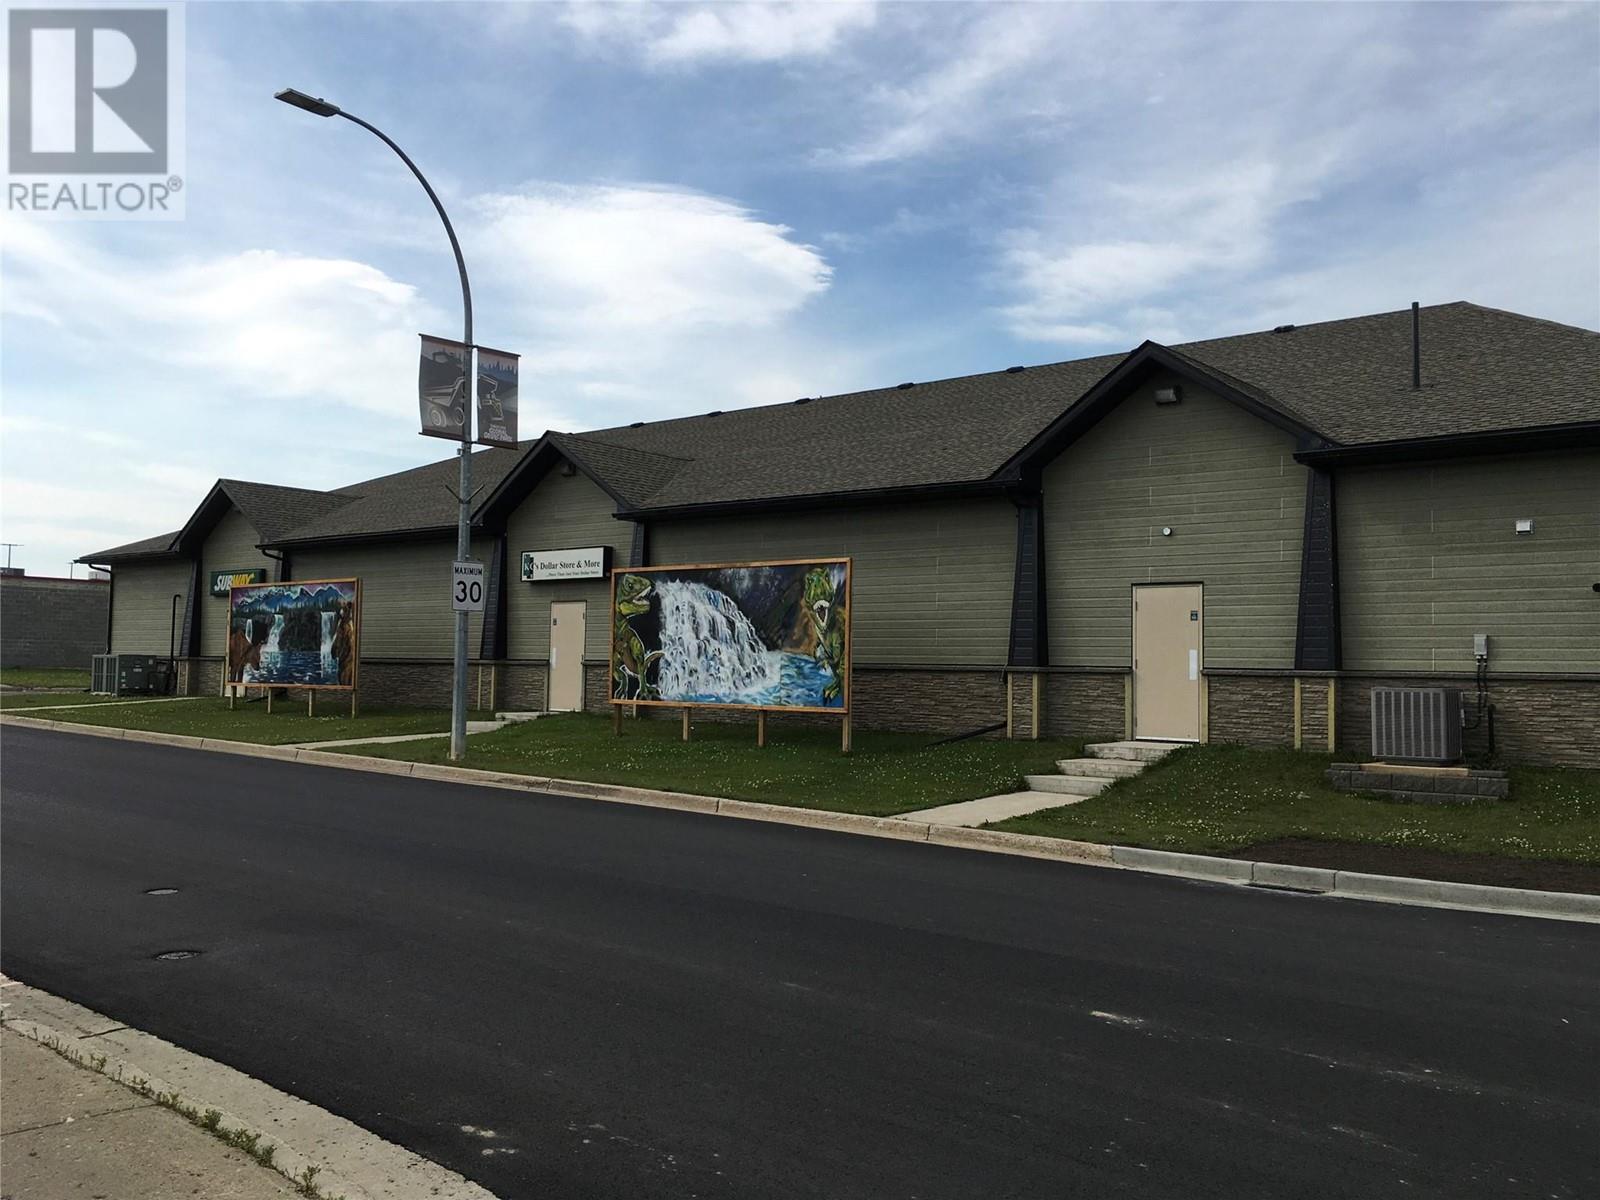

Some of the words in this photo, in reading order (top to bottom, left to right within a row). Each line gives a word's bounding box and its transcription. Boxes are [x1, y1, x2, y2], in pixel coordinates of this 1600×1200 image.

[455, 566, 483, 576] MAXIMUM
[540, 562, 558, 570] Dollar
[560, 561, 576, 569] Store
[576, 560, 583, 568] &
[584, 560, 601, 568] More
[214, 573, 254, 591] SUBWAY
[455, 580, 482, 603] 30
